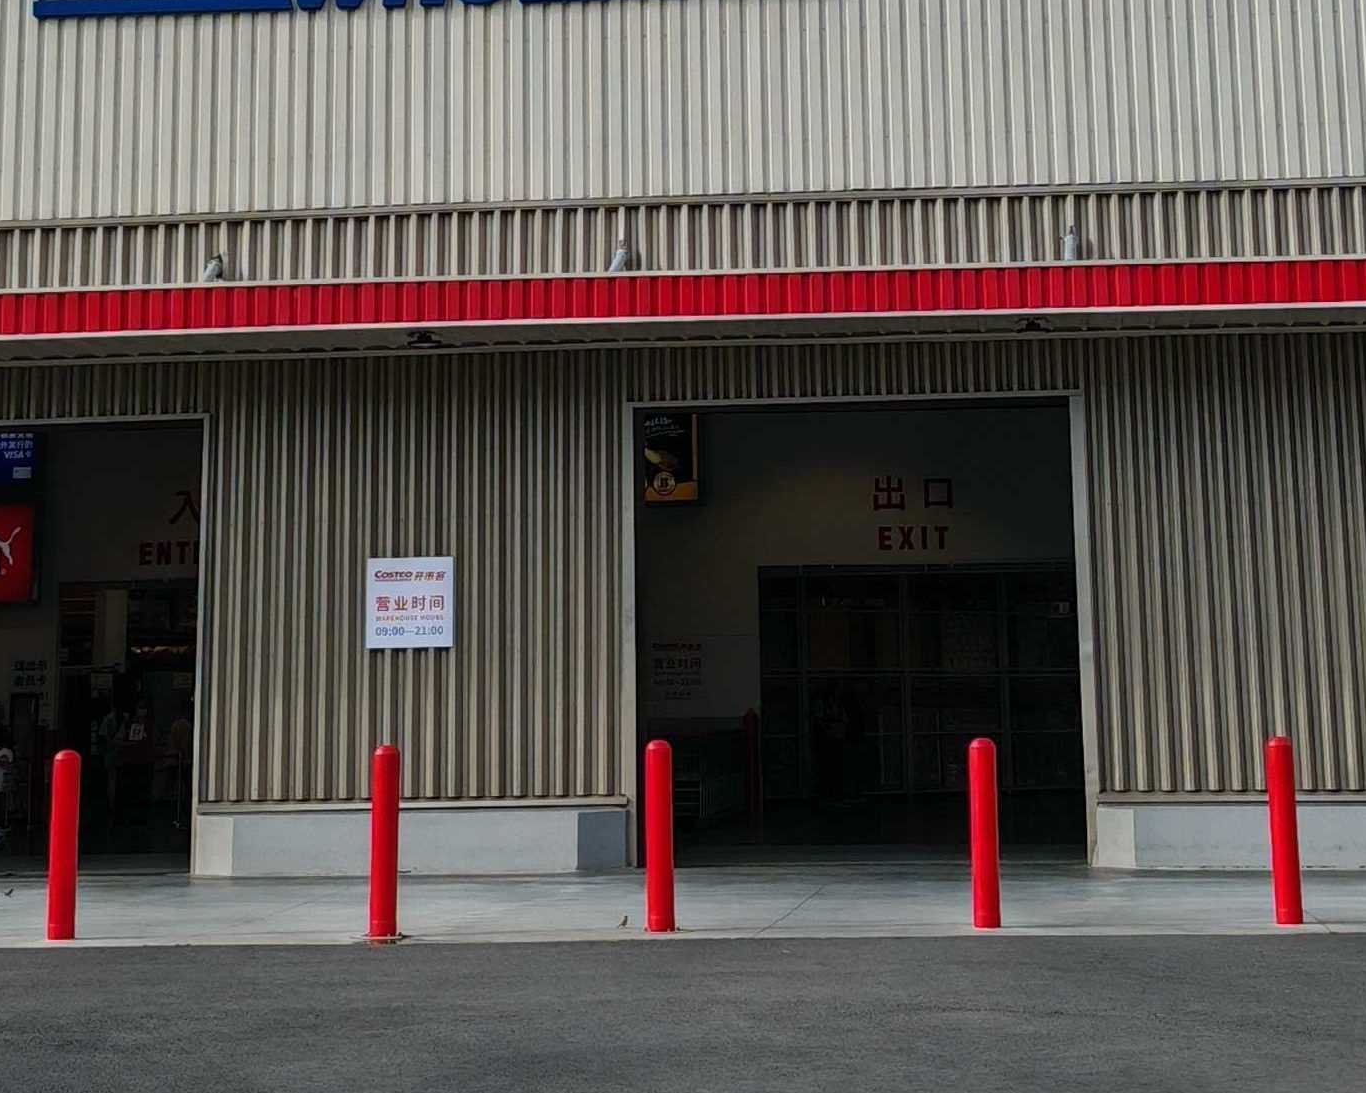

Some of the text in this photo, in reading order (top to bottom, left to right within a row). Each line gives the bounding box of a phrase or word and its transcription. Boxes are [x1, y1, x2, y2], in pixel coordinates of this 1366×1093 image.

[873, 475, 953, 510] 出口
[878, 526, 949, 550] EXIT
[374, 570, 413, 579] COSTCO
[375, 594, 445, 612] 营业时间
